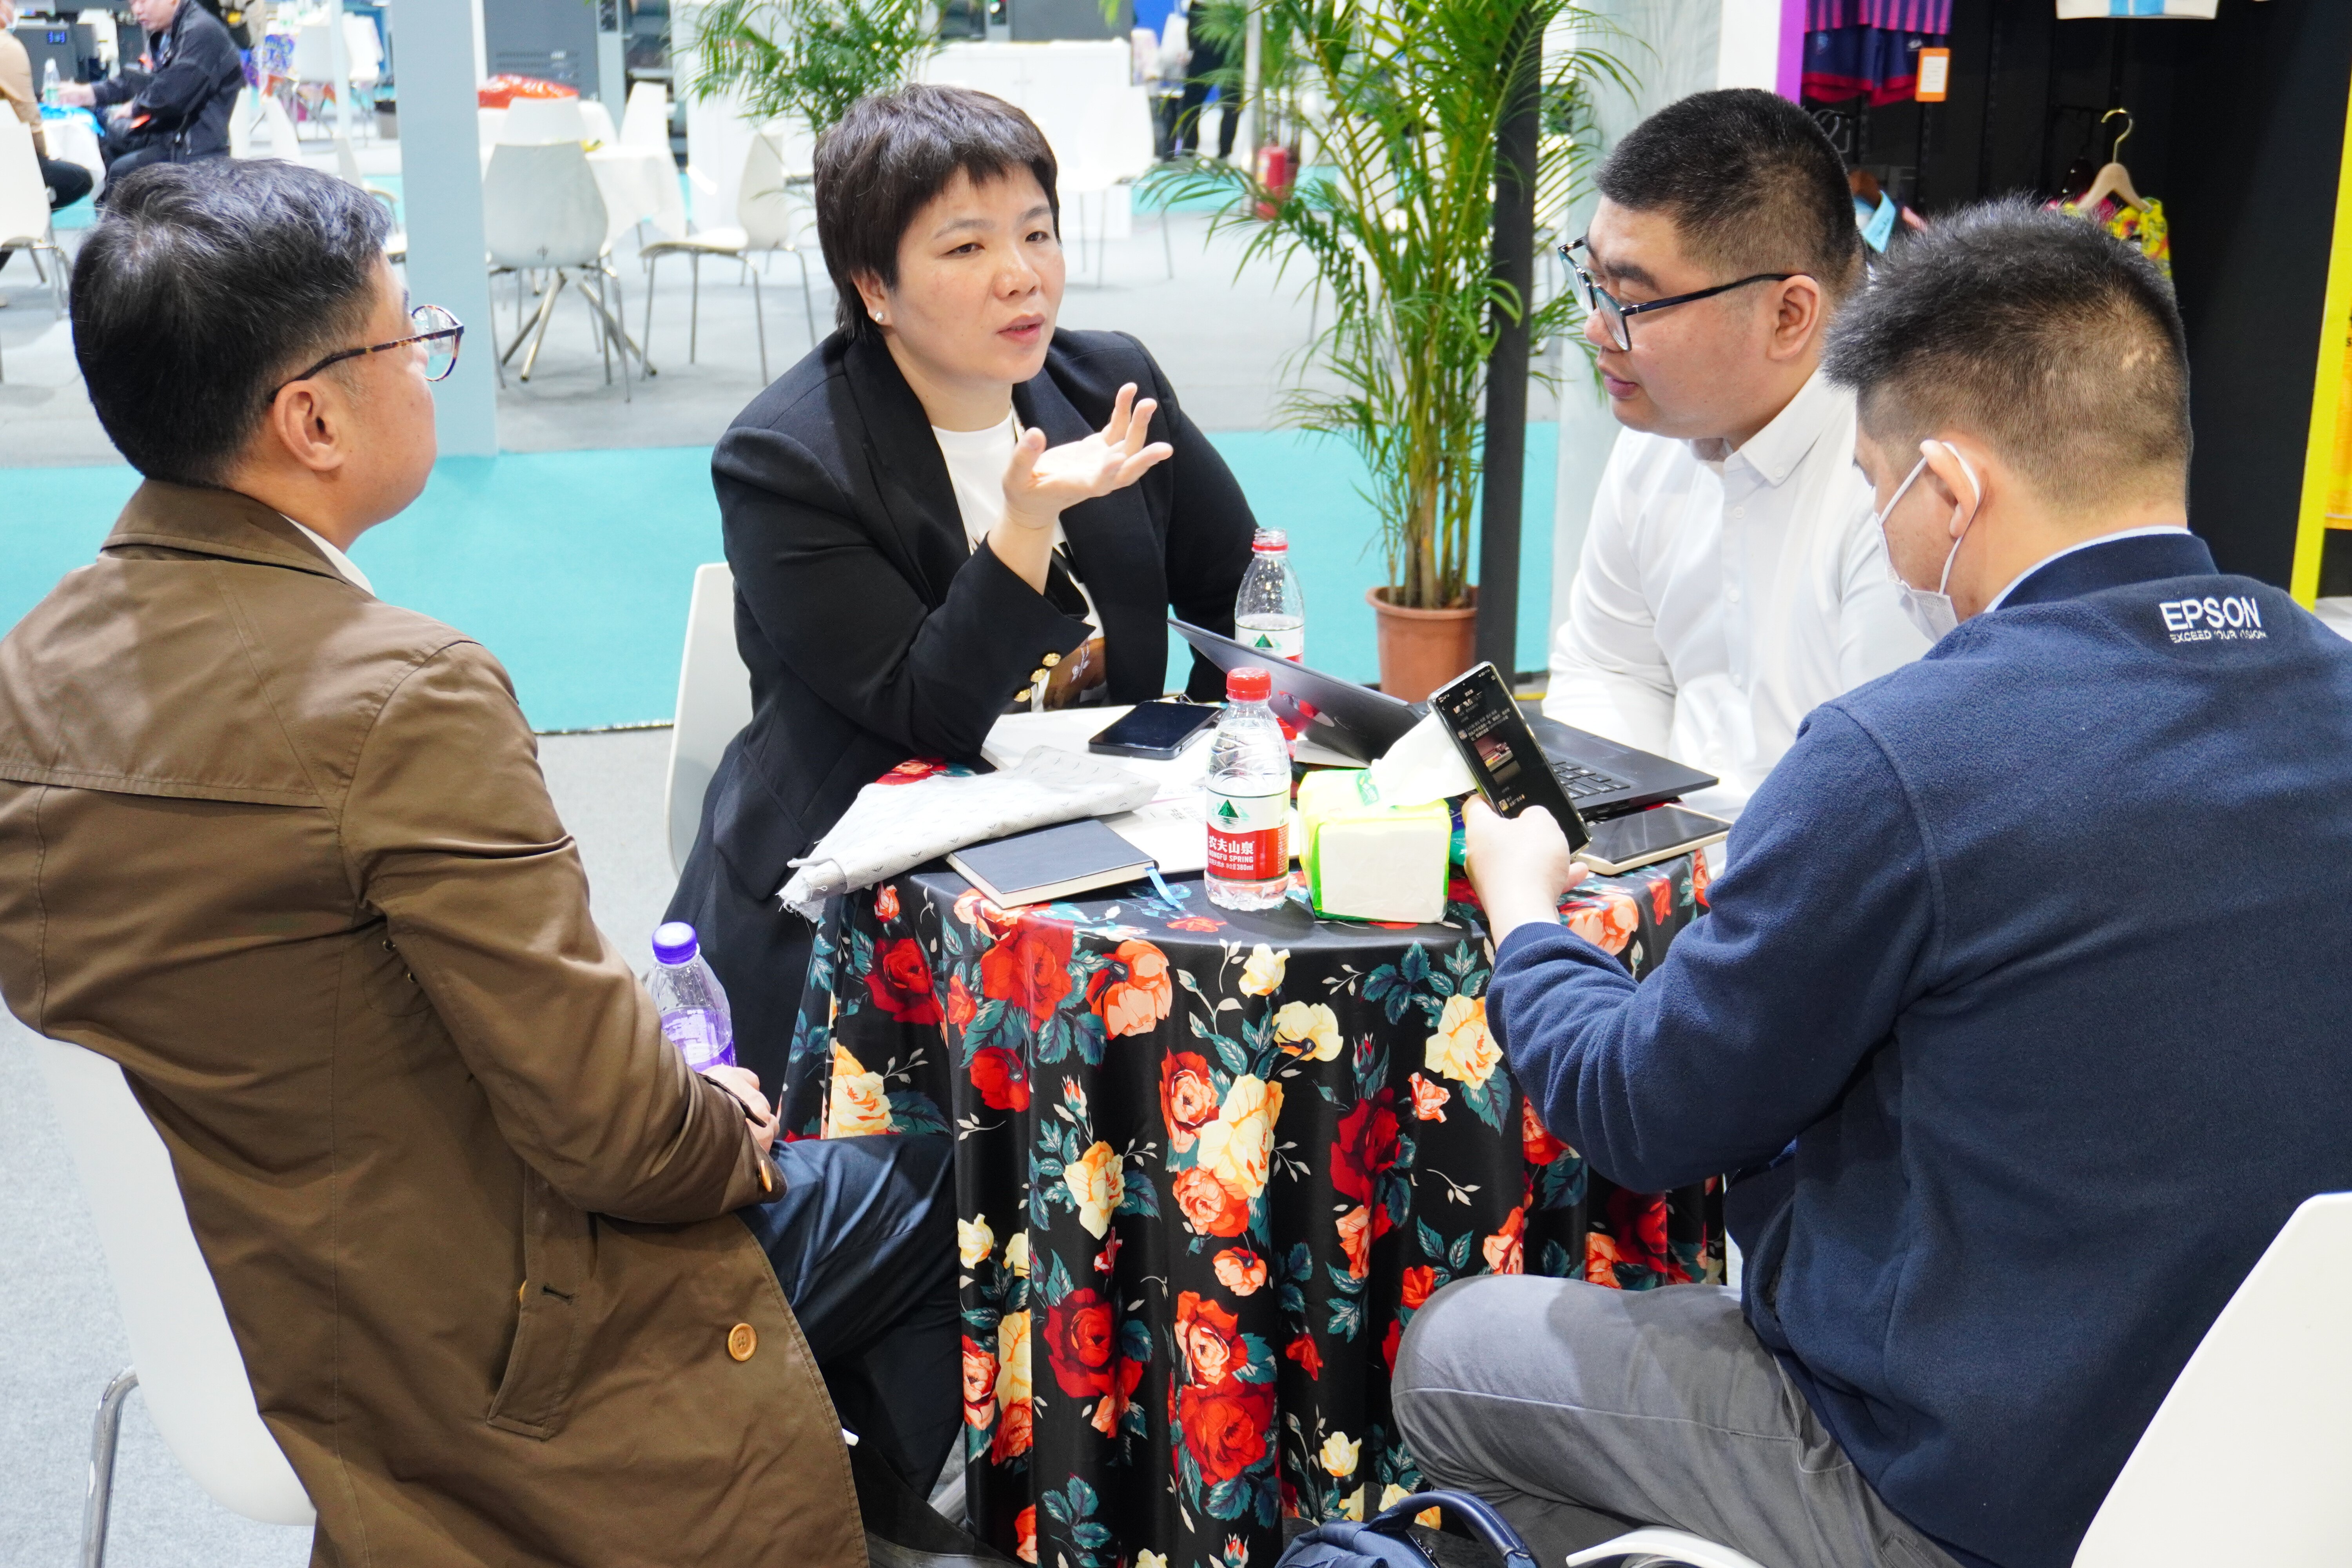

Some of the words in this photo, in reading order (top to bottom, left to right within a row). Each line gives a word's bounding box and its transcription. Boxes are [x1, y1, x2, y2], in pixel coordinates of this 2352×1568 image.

[2159, 596, 2261, 631] EPSON
[2170, 629, 2212, 643] EXCEED
[1209, 835, 1254, 855] 农夫山泉
[1209, 849, 1227, 861] NONGFU
